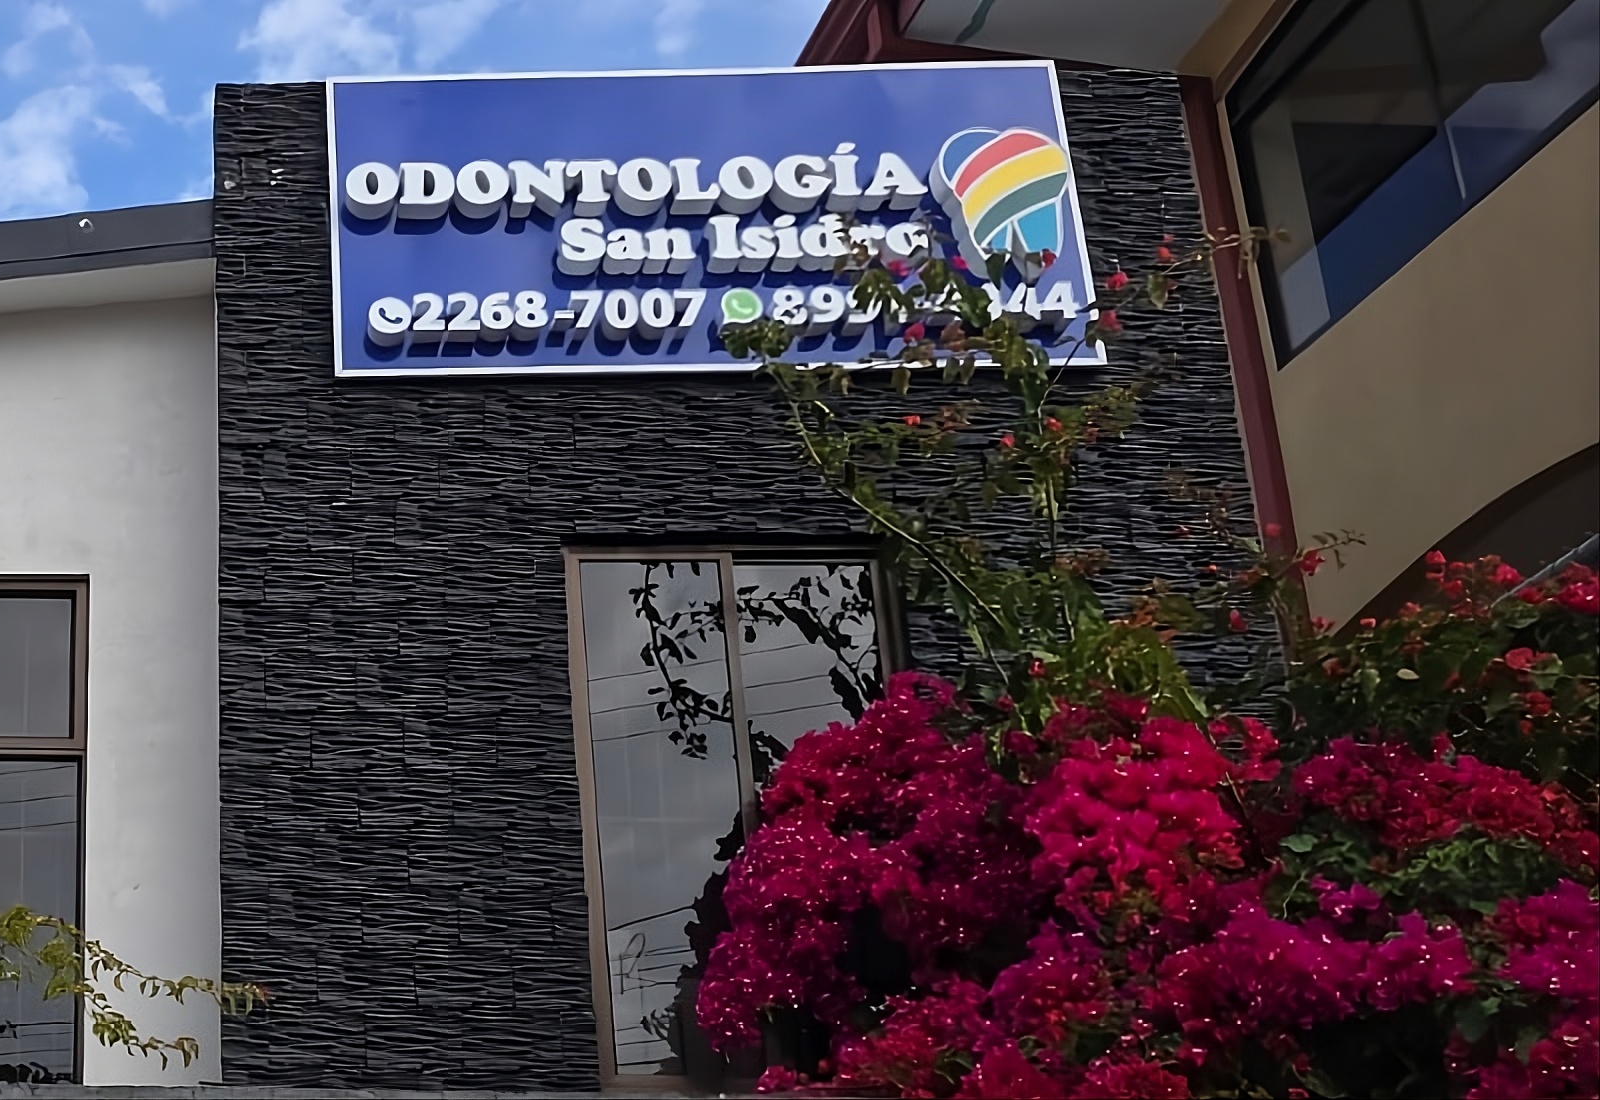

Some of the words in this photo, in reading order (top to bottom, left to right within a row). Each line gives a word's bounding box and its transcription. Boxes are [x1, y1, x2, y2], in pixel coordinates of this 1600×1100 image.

[345, 142, 928, 207] ODONTOLOGÍA
[560, 217, 697, 262] San
[706, 213, 930, 260] Isidro
[412, 287, 707, 332] 2268-7007
